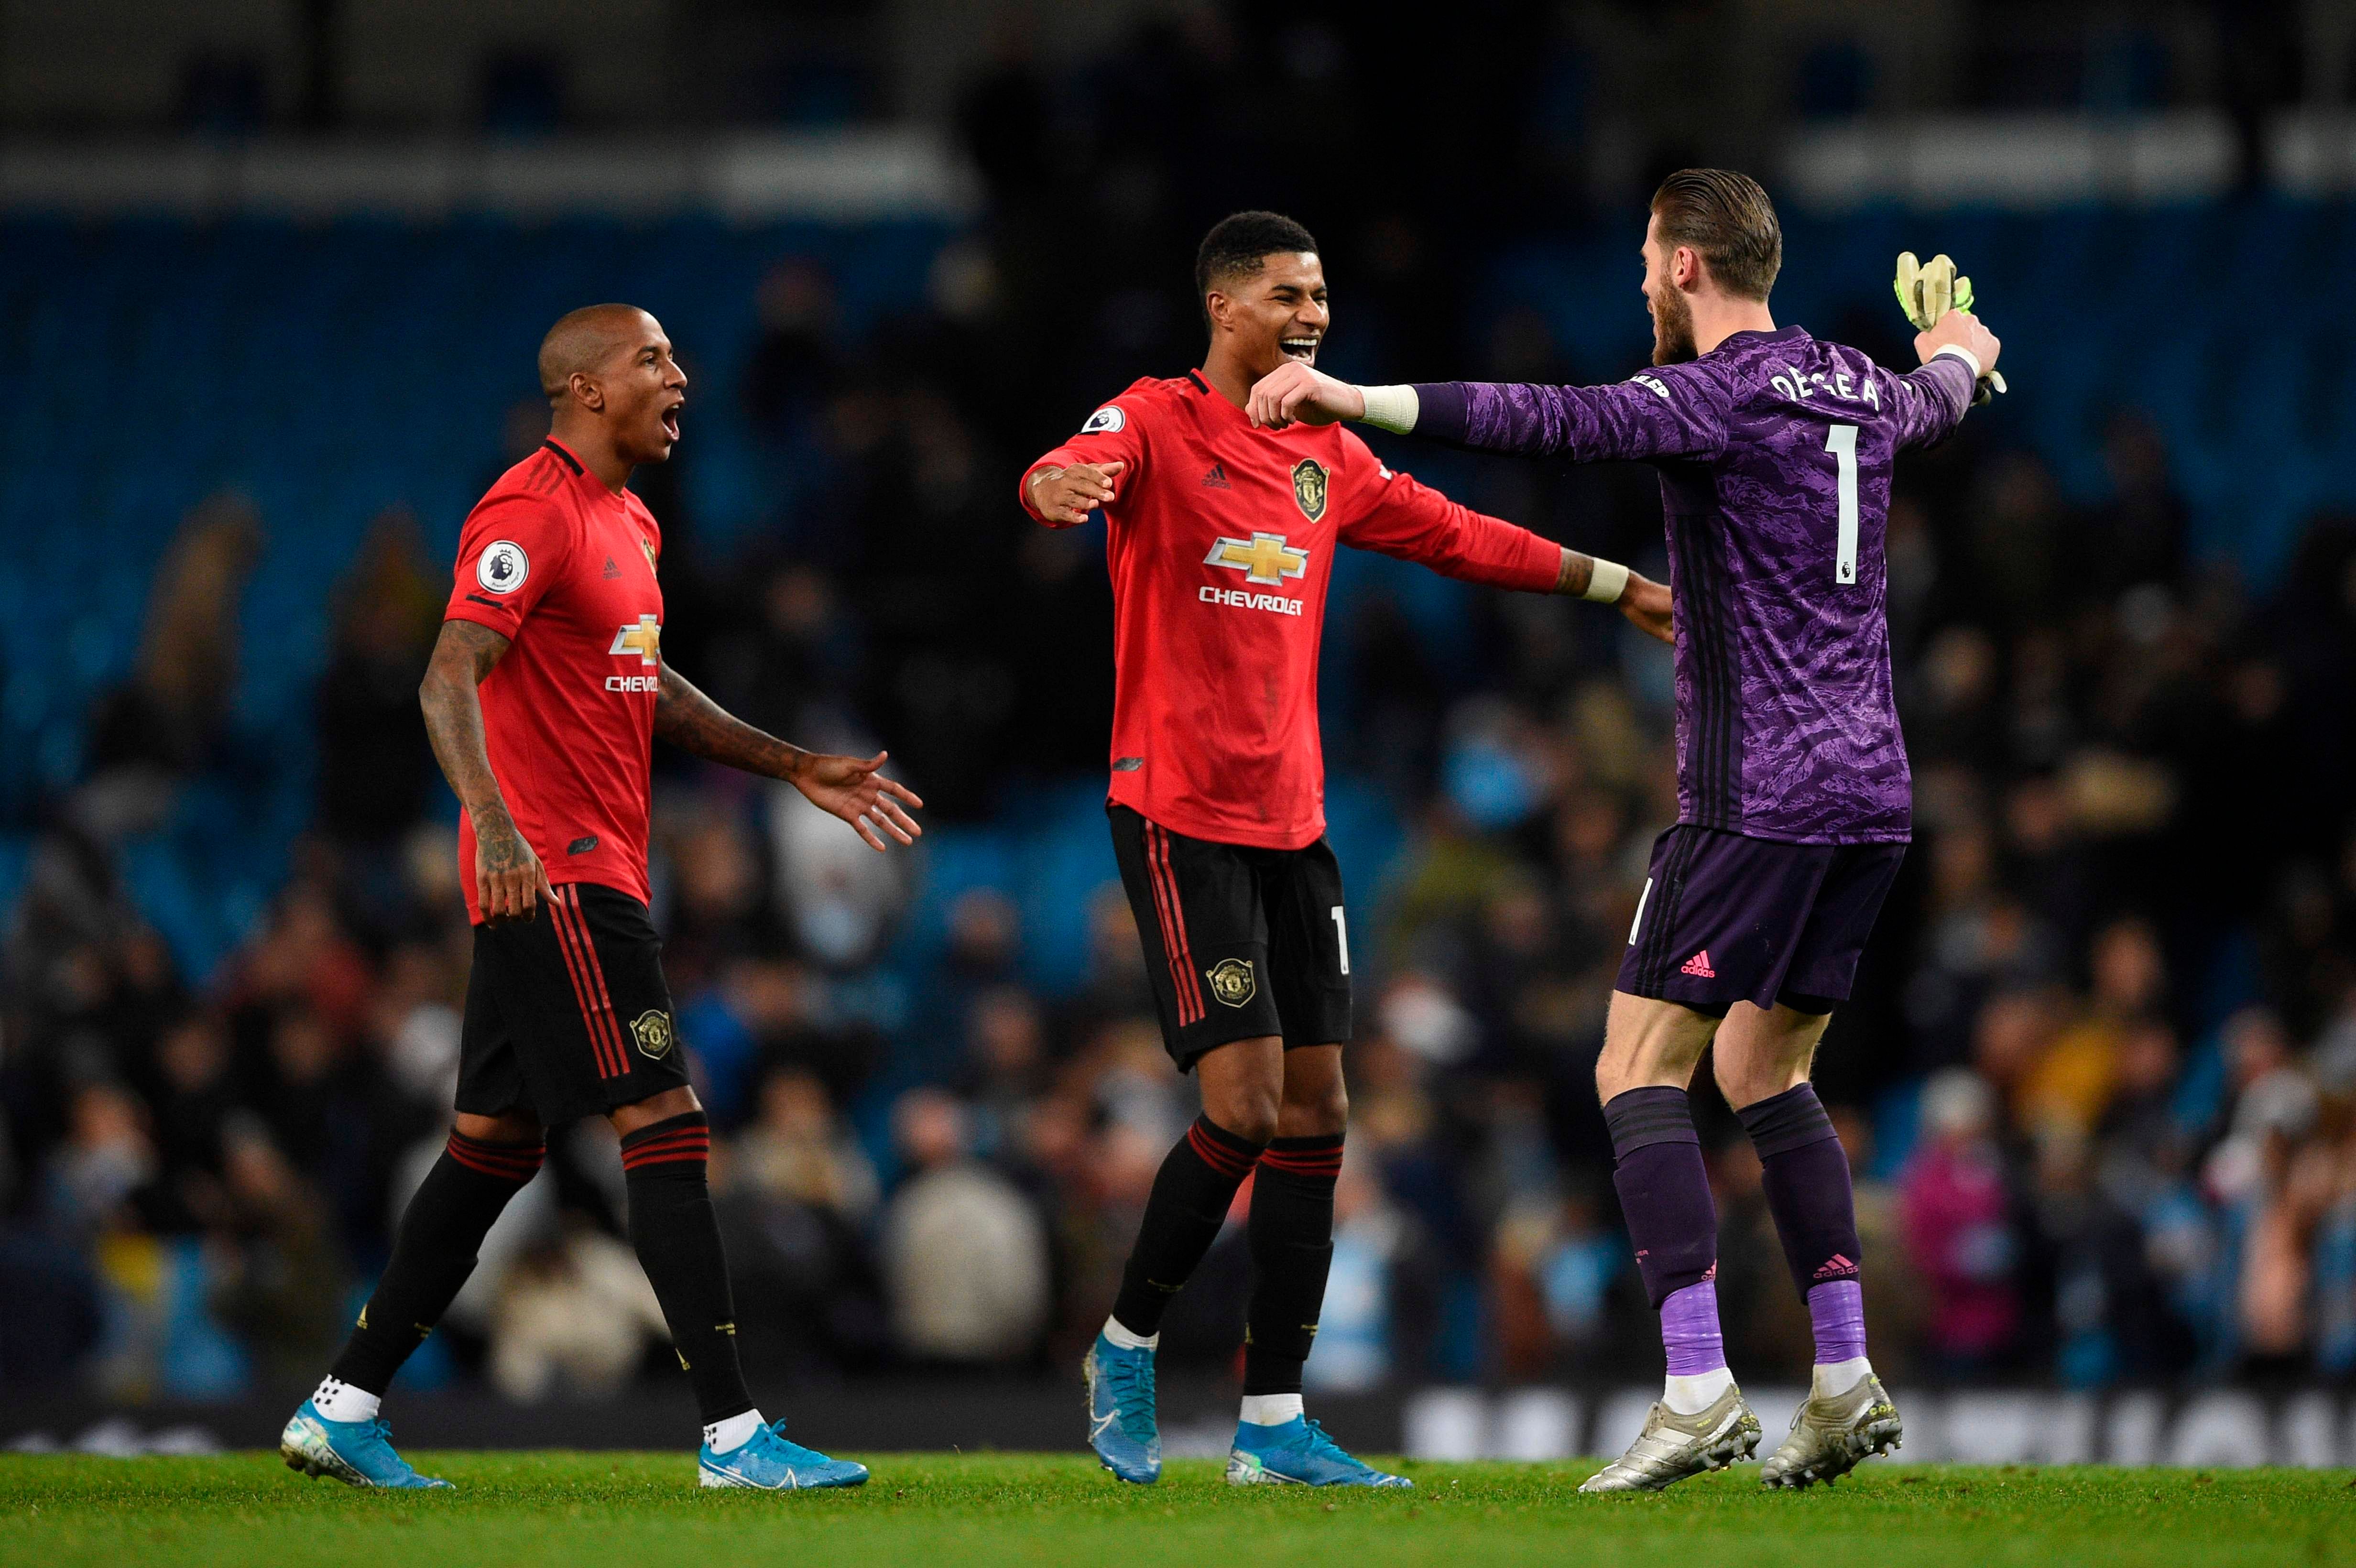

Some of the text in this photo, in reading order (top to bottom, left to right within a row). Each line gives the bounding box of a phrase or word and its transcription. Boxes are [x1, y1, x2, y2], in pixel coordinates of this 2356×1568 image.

[1824, 425, 1859, 584] 1
[1199, 586, 1303, 616] CHEVROLET
[1331, 905, 1350, 975] 1
[1681, 965, 1715, 978] adidas
[1813, 1265, 1859, 1278] adidas
